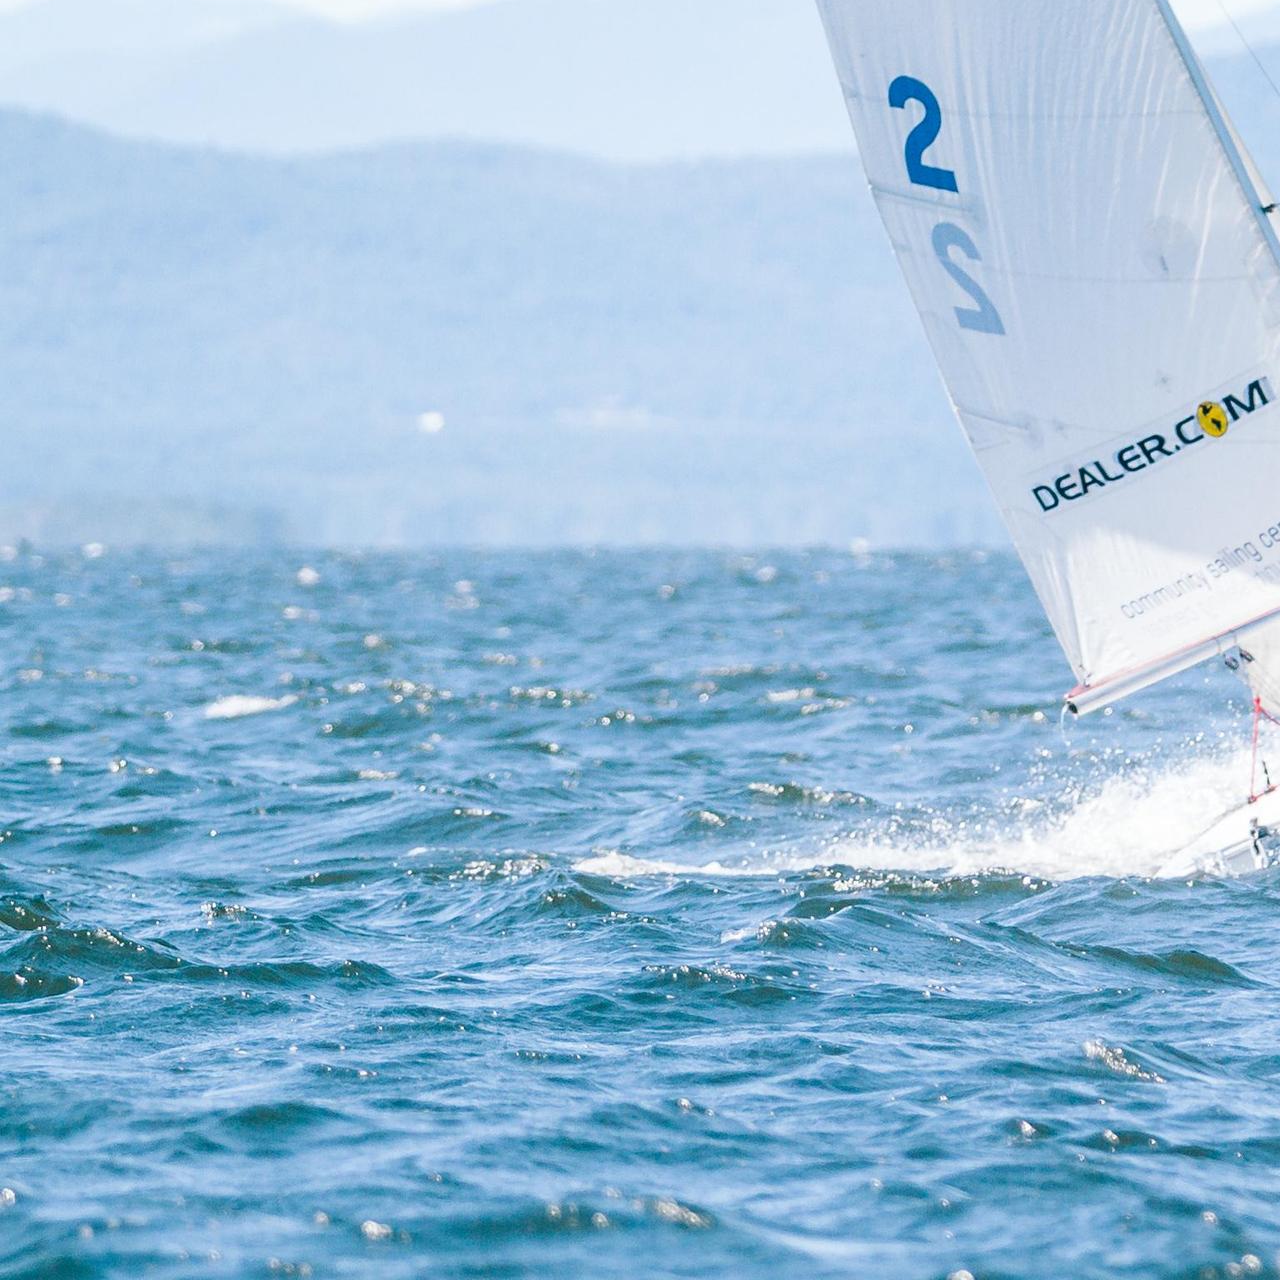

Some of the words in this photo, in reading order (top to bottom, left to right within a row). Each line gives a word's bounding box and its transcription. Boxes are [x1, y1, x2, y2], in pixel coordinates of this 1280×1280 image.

[888, 75, 959, 193] 2
[1120, 570, 1212, 619] community
[1206, 541, 1263, 578] sailing
